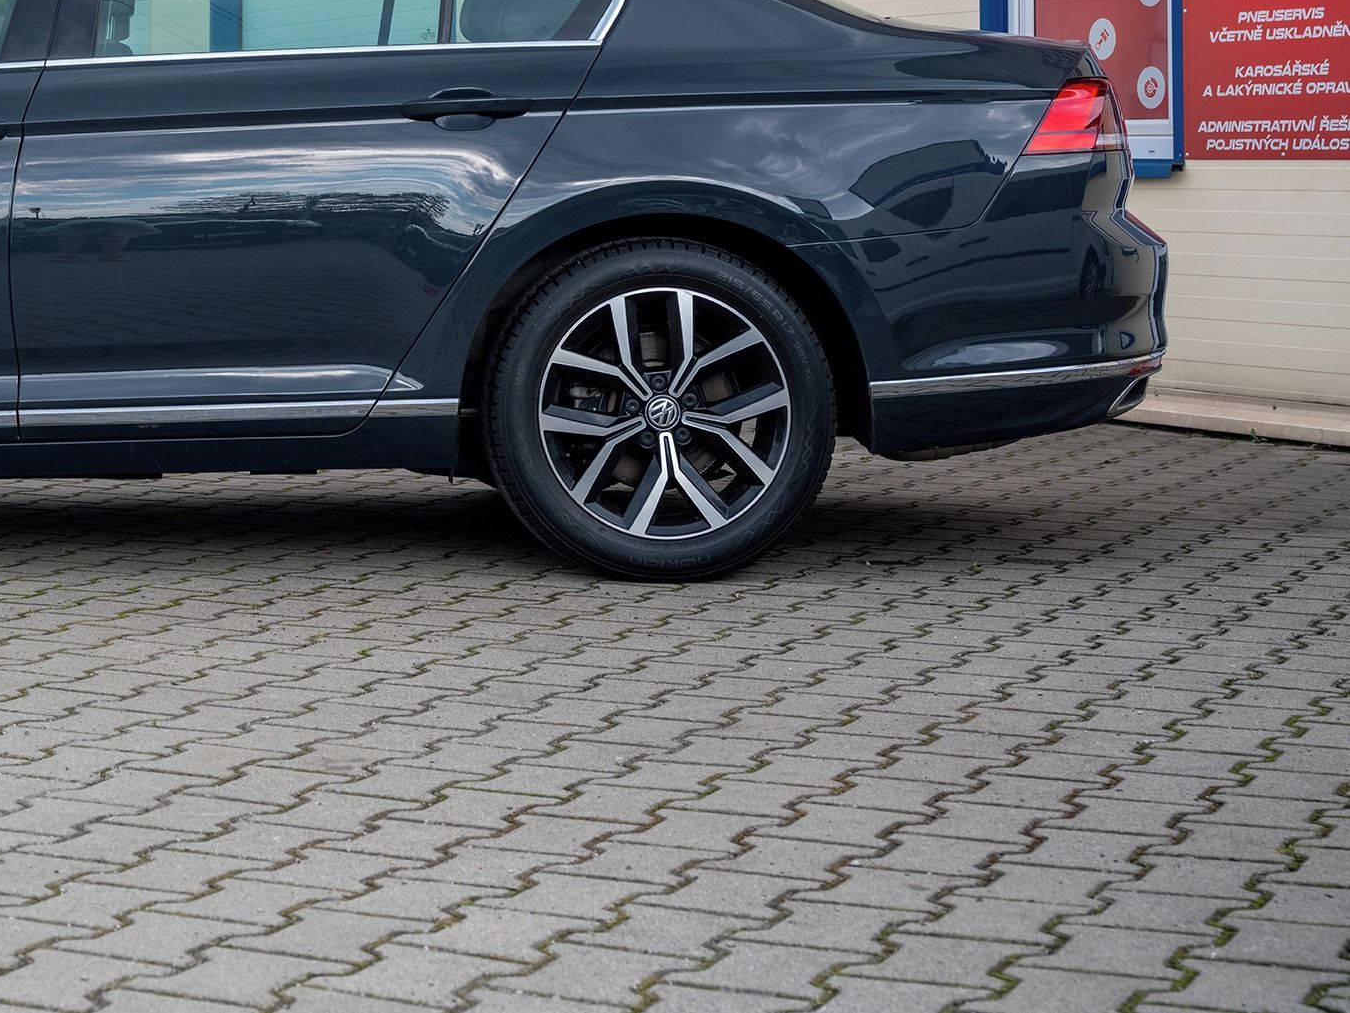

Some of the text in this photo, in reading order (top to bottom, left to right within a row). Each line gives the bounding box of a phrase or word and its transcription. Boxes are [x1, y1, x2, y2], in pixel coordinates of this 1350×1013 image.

[1237, 7, 1325, 24] PNEUSERVIS
[1209, 24, 1263, 43] VČETNĚ
[1235, 59, 1330, 78] KAROSÁŘSKÉ
[1202, 84, 1213, 97] A
[1216, 78, 1303, 97] LAKÝRNICKÉ
[1198, 115, 1350, 133] ADMINISTRATIVNÍ ŘEŠ
[1206, 134, 1289, 151] POJISTNÝCH
